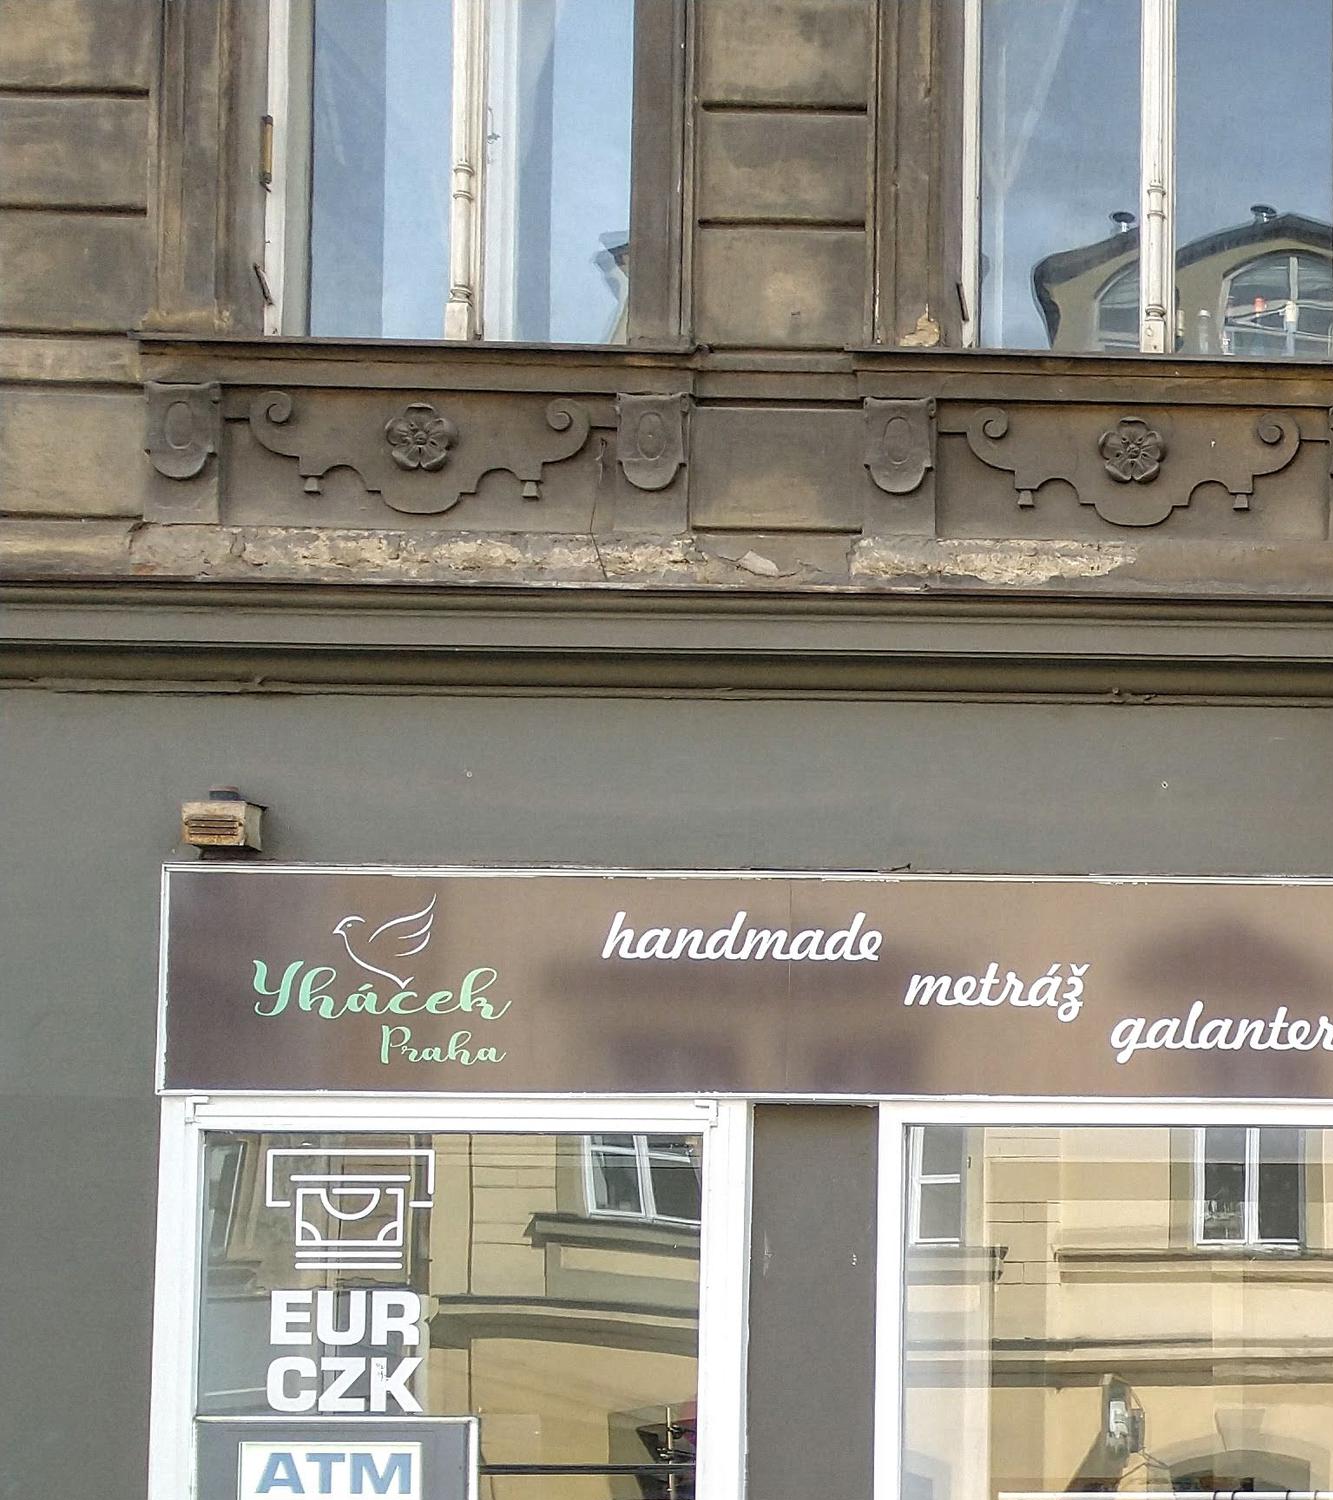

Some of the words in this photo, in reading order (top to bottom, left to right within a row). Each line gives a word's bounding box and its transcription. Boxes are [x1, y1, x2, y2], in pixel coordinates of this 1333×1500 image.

[601, 911, 882, 961] handmade
[904, 963, 1090, 1022] metráž
[380, 1025, 508, 1066] Praha
[270, 1290, 421, 1346] EUR
[266, 1356, 424, 1413] CZK
[256, 1452, 411, 1494] ATM
